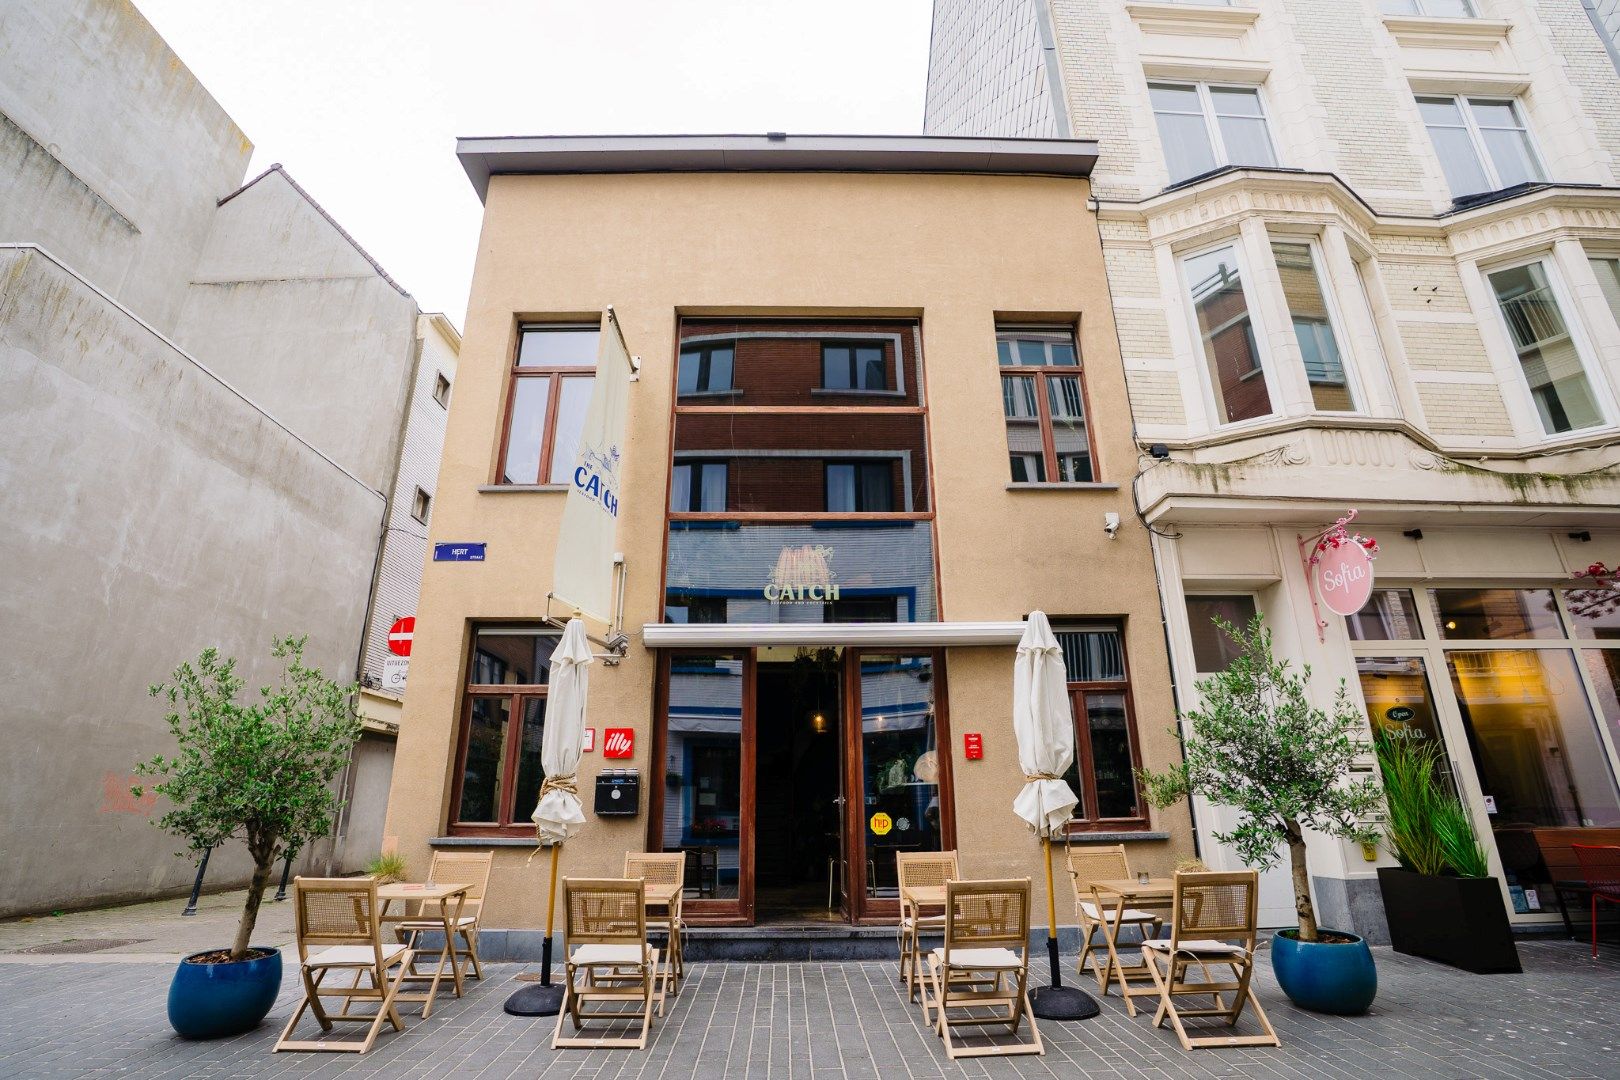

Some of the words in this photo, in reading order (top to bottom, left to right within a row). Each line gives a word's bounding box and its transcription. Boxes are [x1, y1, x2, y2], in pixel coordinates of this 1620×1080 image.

[574, 466, 618, 517] CATCH
[1323, 561, 1366, 594] Sofia
[763, 584, 840, 601] CATCH
[605, 732, 632, 756] illy
[1385, 721, 1427, 746] Sofia
